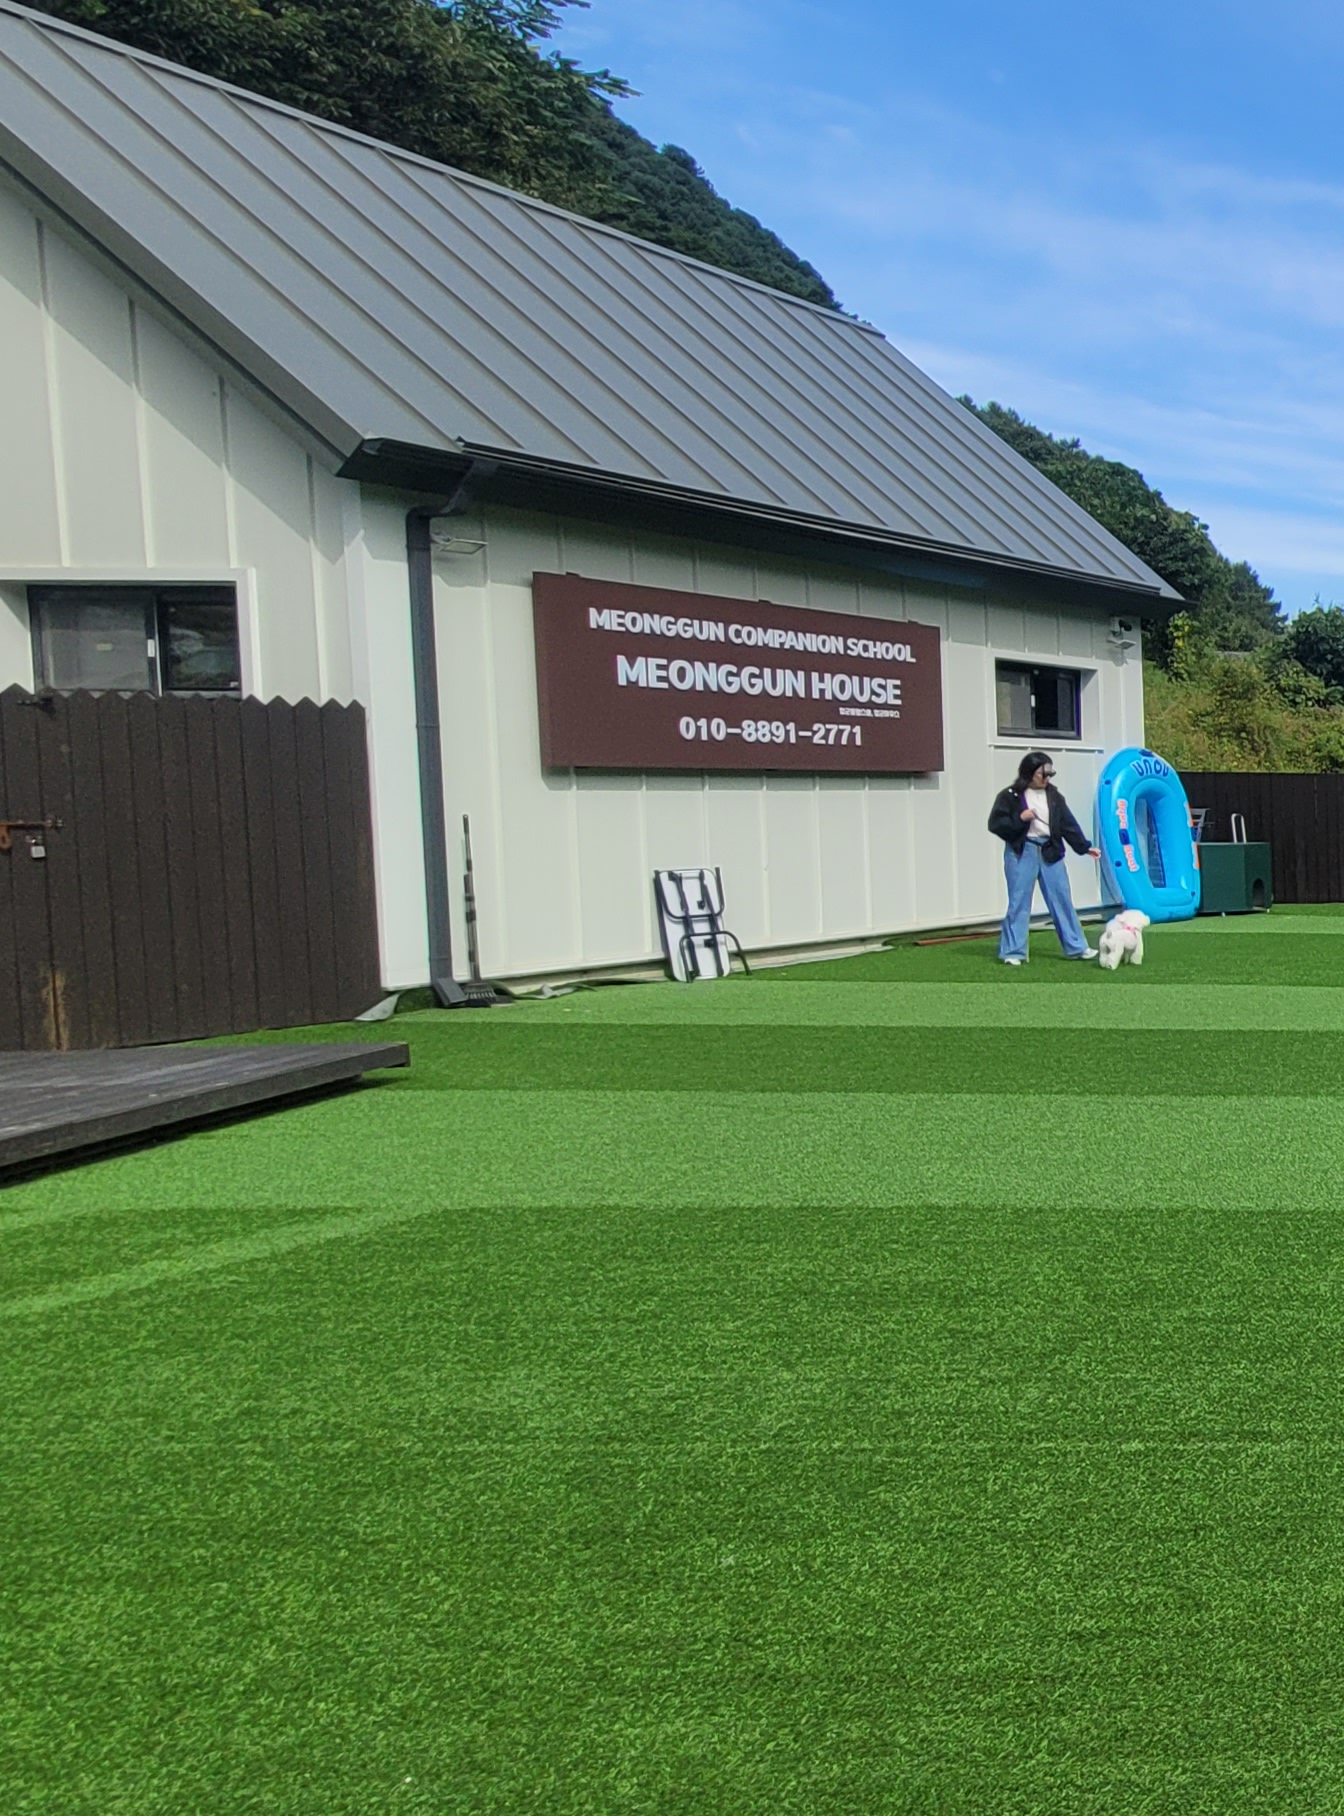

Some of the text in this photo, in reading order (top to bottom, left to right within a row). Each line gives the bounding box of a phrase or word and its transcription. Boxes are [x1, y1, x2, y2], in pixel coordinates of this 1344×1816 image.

[589, 607, 917, 663] MEONGGUN COMPANION SCHOOL
[616, 654, 902, 705] MEONGGUN HOUSE
[679, 716, 862, 746] 010-8891-2771
